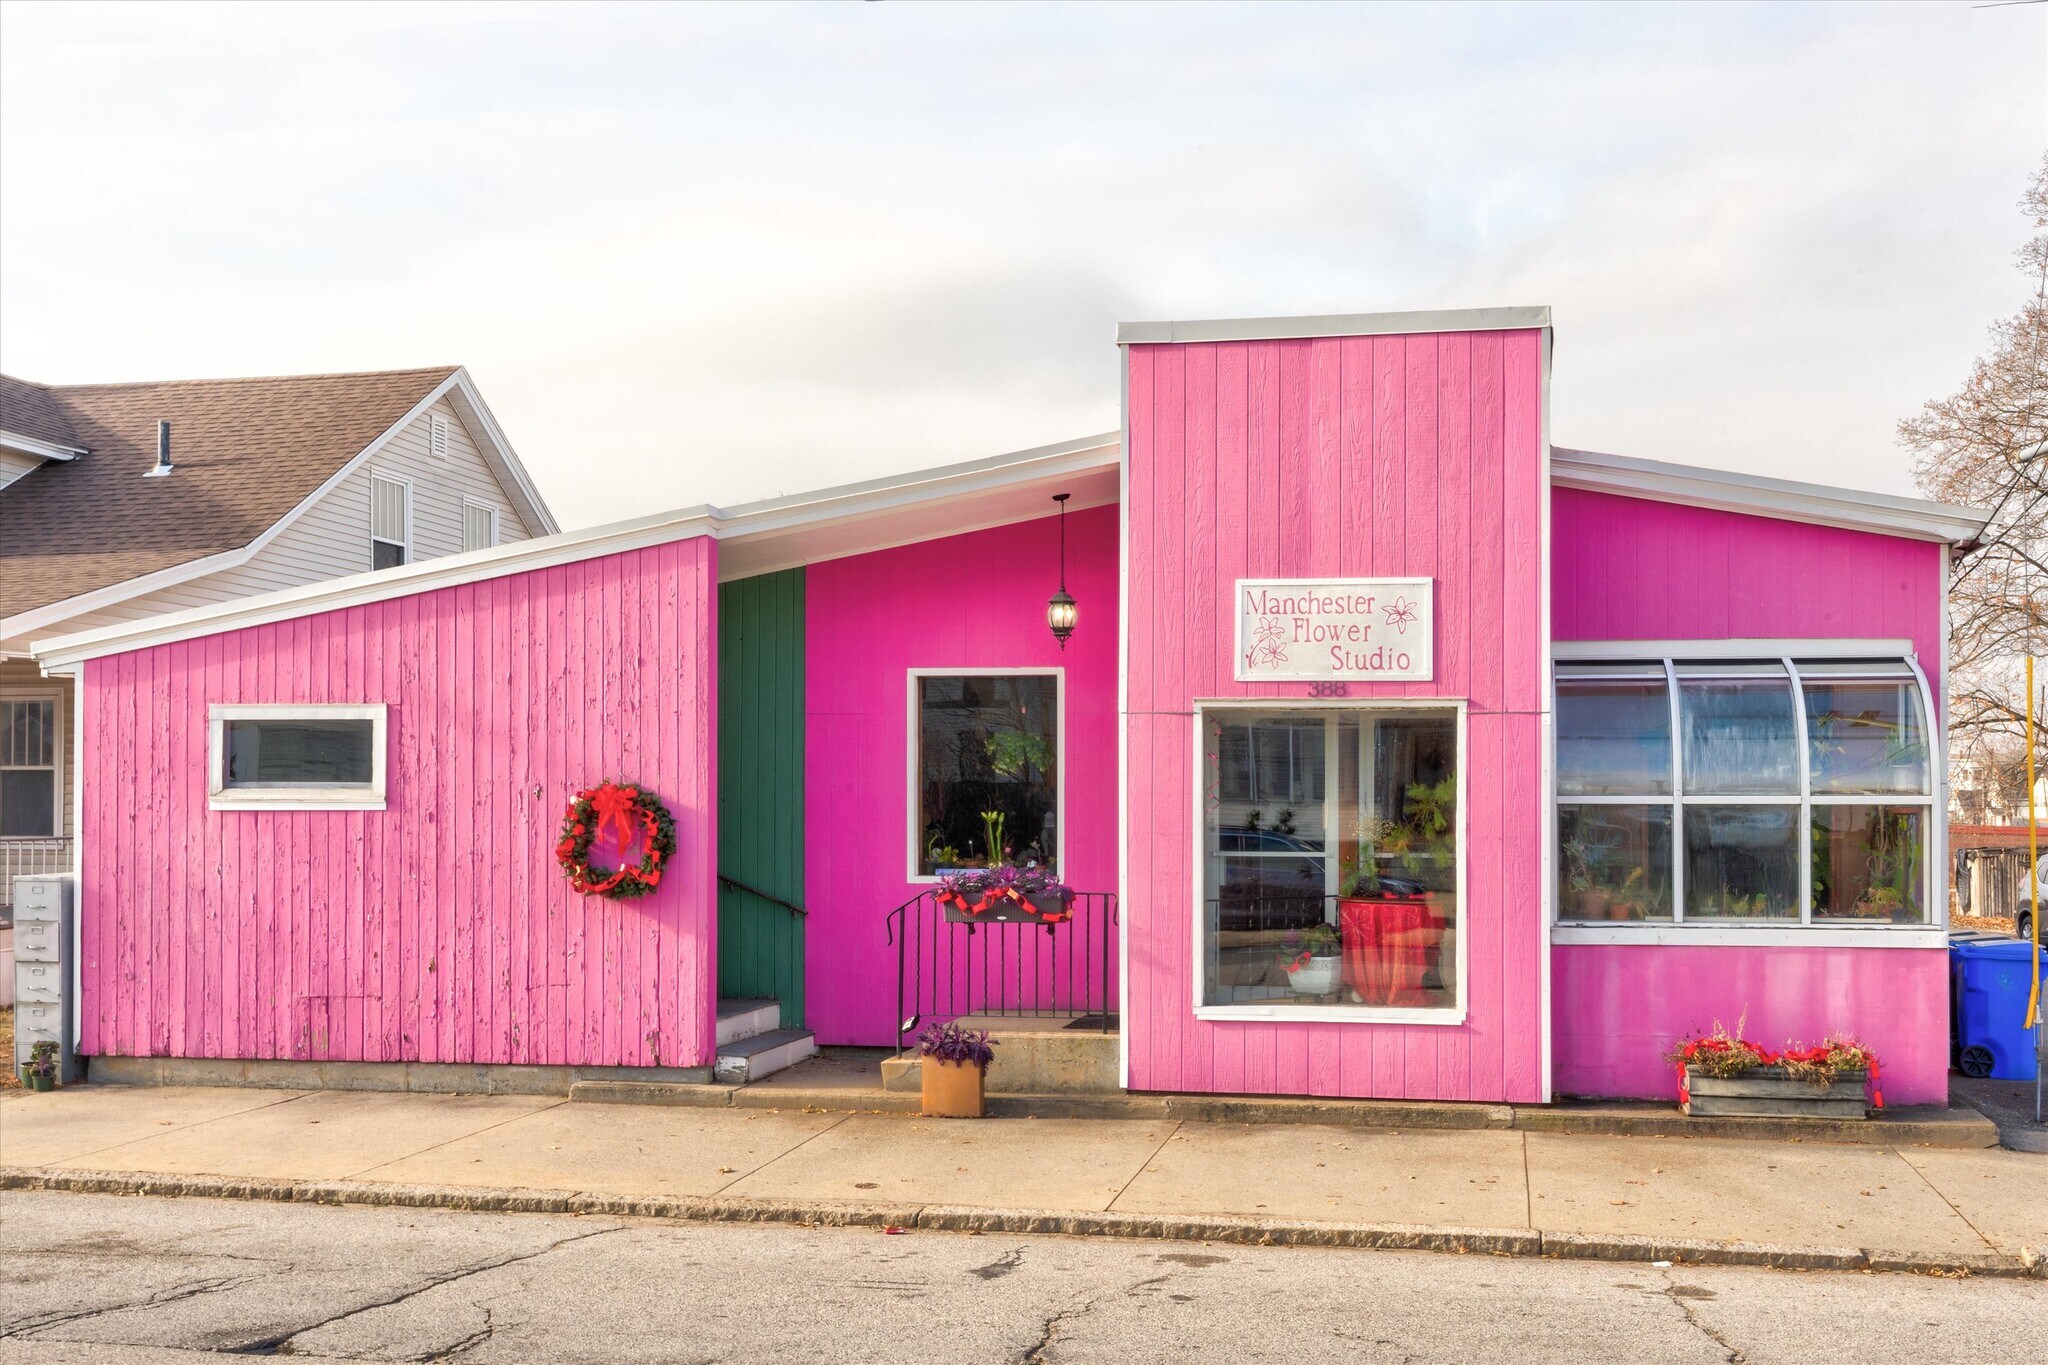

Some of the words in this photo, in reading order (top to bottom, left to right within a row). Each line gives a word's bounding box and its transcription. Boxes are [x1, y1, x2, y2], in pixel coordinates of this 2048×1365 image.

[1246, 590, 1375, 615] Manchester
[1292, 617, 1371, 643] Flower
[1330, 645, 1410, 671] Studio
[1308, 681, 1346, 698] 388
